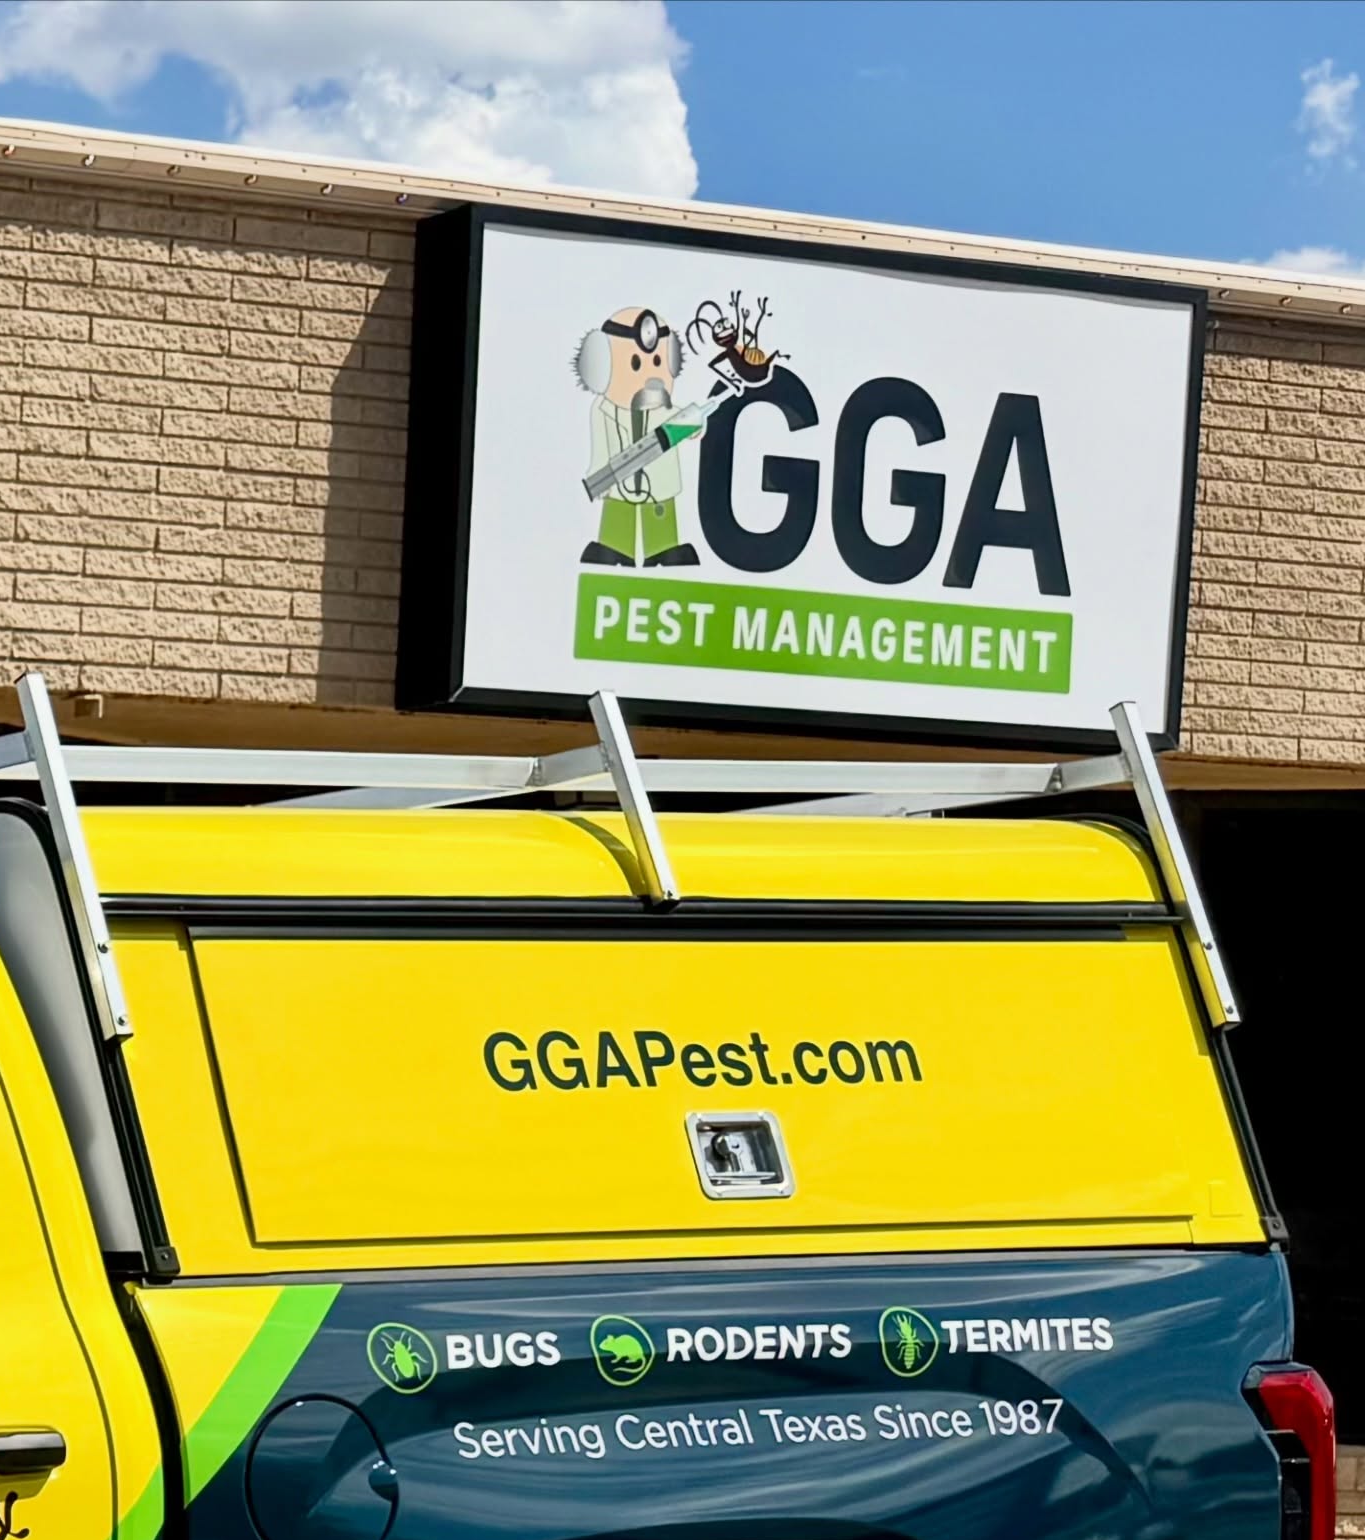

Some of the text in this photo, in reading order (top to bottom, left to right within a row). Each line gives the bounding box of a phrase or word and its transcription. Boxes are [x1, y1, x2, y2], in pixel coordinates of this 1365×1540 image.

[697, 365, 1071, 596] GGA
[593, 595, 1058, 673] PEST MANAGEMENT
[482, 1029, 924, 1092] GGAPest.com
[446, 1331, 561, 1370] BUGS
[666, 1323, 852, 1363] RODENTS
[941, 1316, 1115, 1353] TERMITES
[453, 1397, 1064, 1459] Serving Central Texas Since 1987
